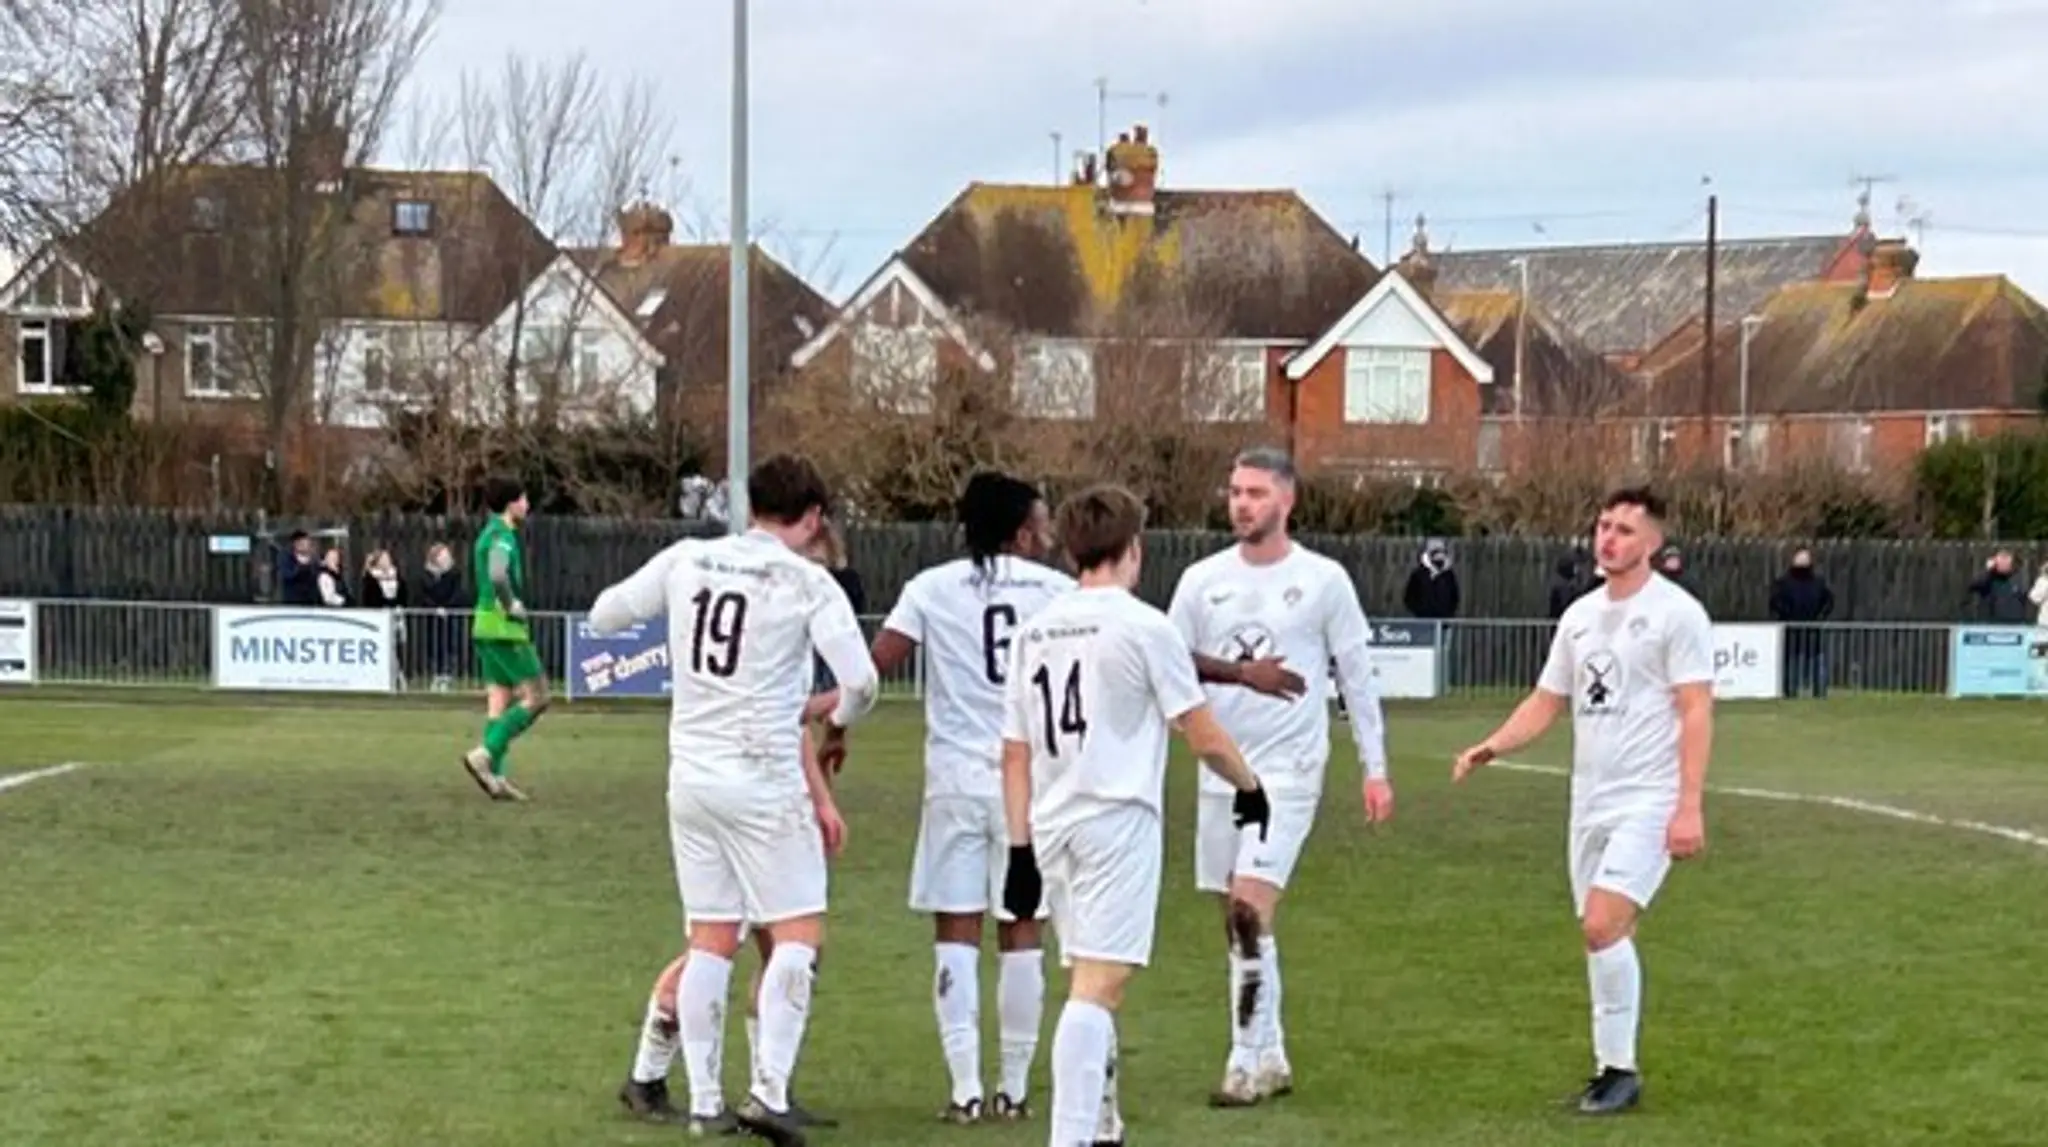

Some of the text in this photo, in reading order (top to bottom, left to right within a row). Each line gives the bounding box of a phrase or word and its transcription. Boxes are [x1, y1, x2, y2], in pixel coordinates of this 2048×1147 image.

[231, 635, 379, 665] MINSTER
[692, 587, 748, 678] 19
[983, 604, 1017, 685] 6
[1031, 658, 1087, 758] 14
